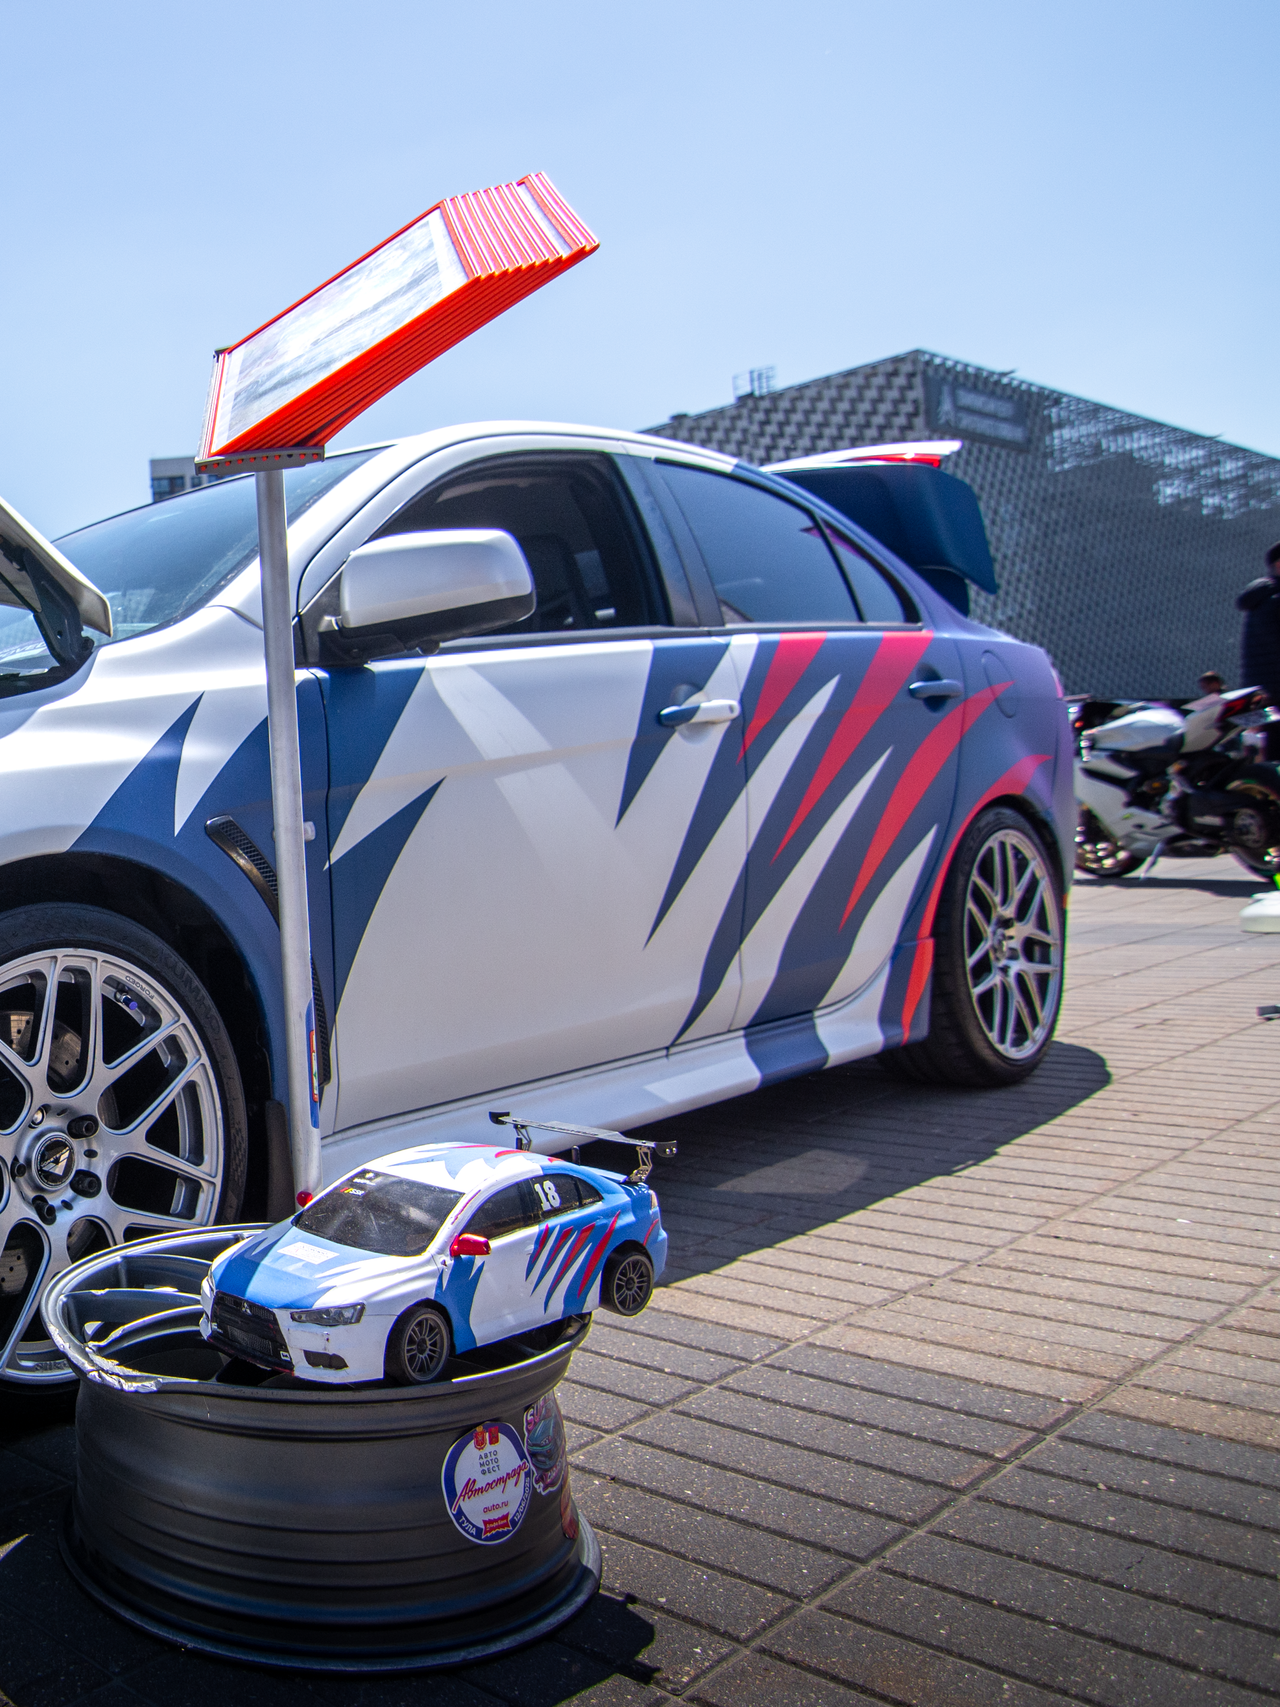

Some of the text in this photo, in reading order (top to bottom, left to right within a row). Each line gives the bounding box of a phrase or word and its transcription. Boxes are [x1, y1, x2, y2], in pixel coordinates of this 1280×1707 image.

[125, 975, 155, 999] FORGED
[534, 1180, 561, 1211] 18
[478, 1450, 498, 1460] АВТО
[479, 1457, 499, 1468] МОТО
[480, 1464, 501, 1475] ФЕСТ
[452, 1460, 529, 1513] Автострада
[483, 1501, 509, 1513] auto.ru
[459, 1516, 476, 1535] ТУЛА
